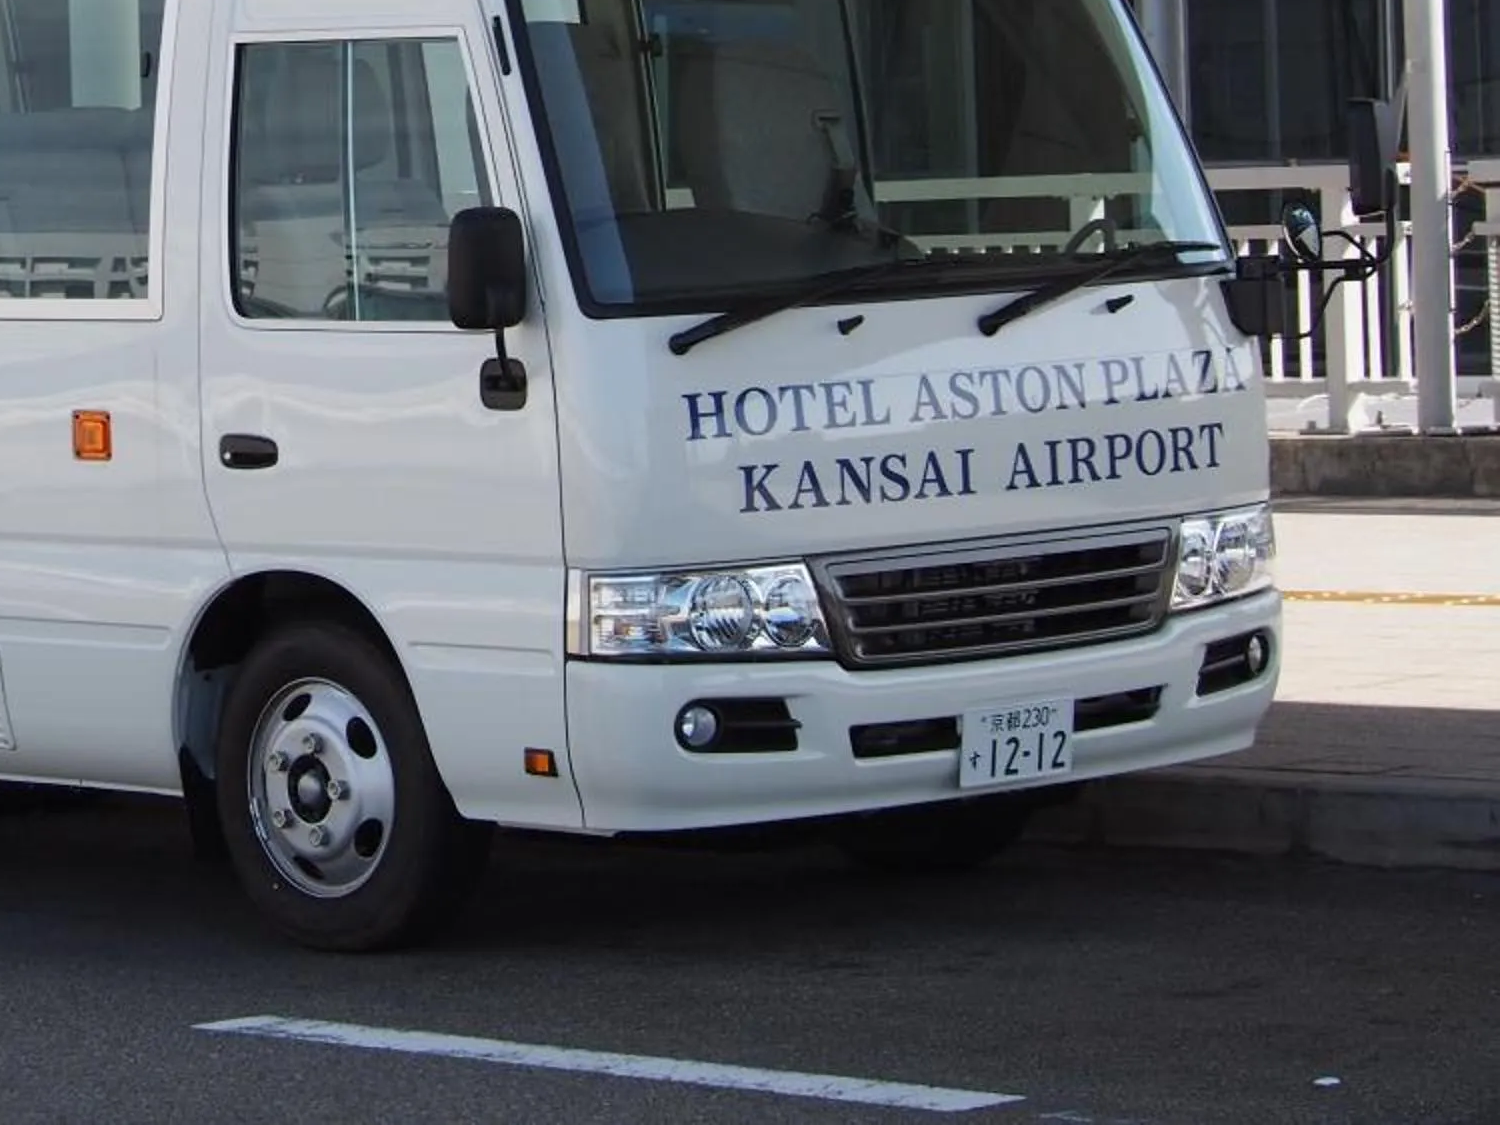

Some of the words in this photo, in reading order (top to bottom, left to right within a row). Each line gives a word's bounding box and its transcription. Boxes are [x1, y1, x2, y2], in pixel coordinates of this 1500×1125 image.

[682, 379, 891, 442] HOTEL
[909, 361, 1088, 423] ASTON
[1103, 346, 1248, 405] PLAZA
[738, 447, 976, 514] KANSAI
[1005, 422, 1225, 492] AIRPORT
[990, 730, 1066, 777] 12-12
